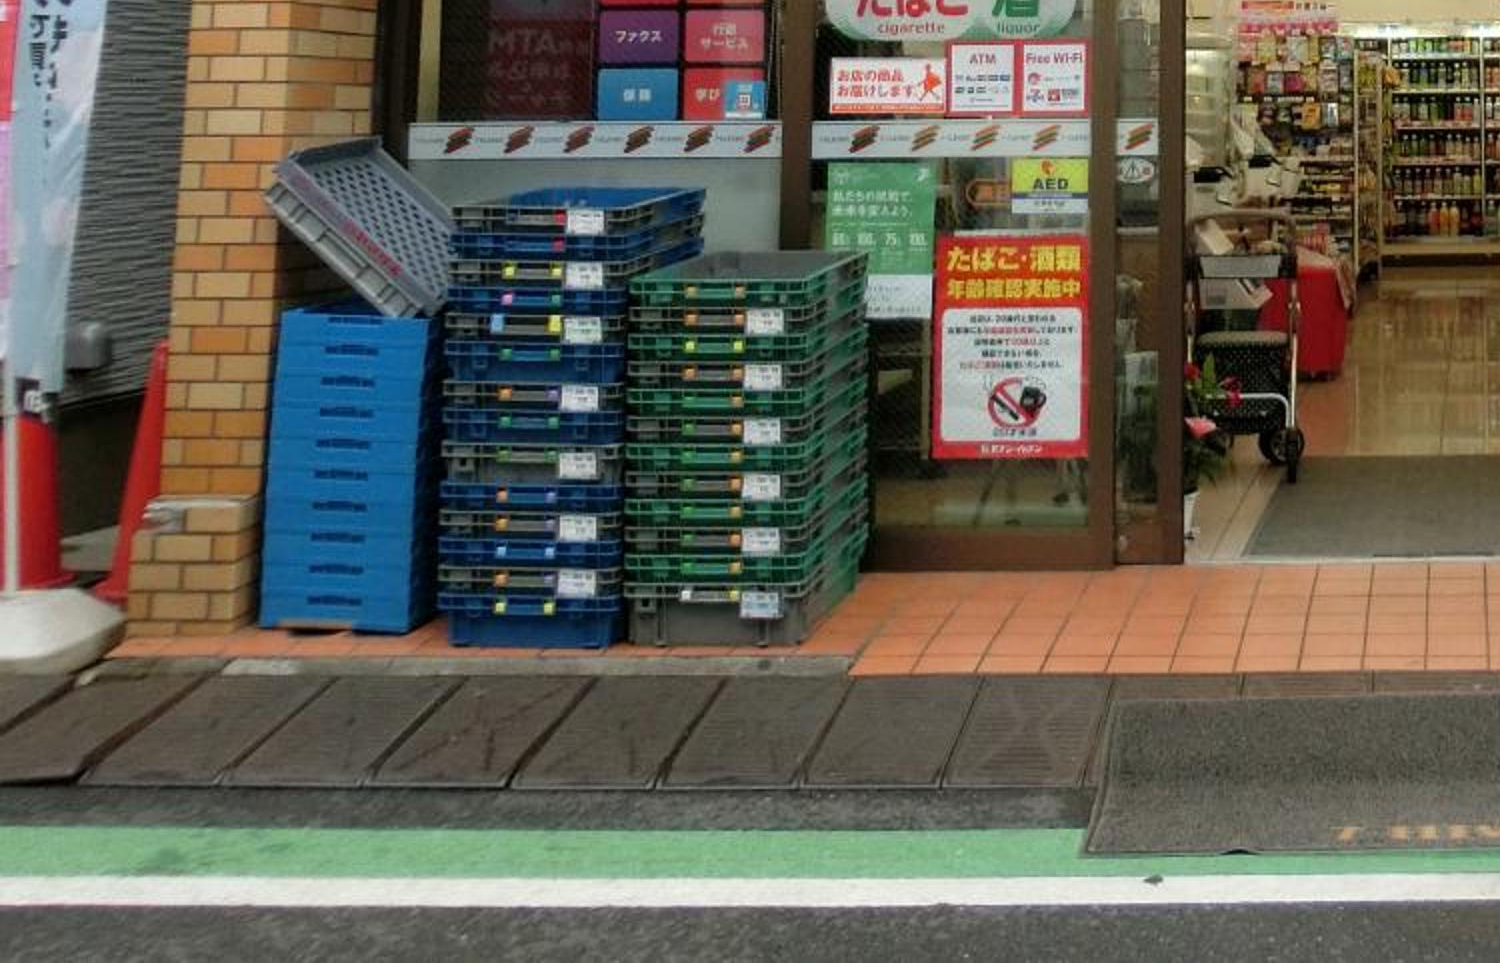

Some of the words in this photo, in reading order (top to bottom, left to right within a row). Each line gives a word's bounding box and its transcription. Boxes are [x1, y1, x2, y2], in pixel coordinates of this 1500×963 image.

[876, 21, 945, 35] cigarette
[996, 21, 1041, 35] liquor
[615, 29, 663, 44] ファクス
[700, 38, 748, 50] サービス
[969, 52, 997, 65] ATM
[1025, 52, 1051, 64] Free
[837, 68, 904, 83] お店の商品
[1033, 178, 1069, 190] AED
[946, 278, 1081, 300] 年齢確認実施中
